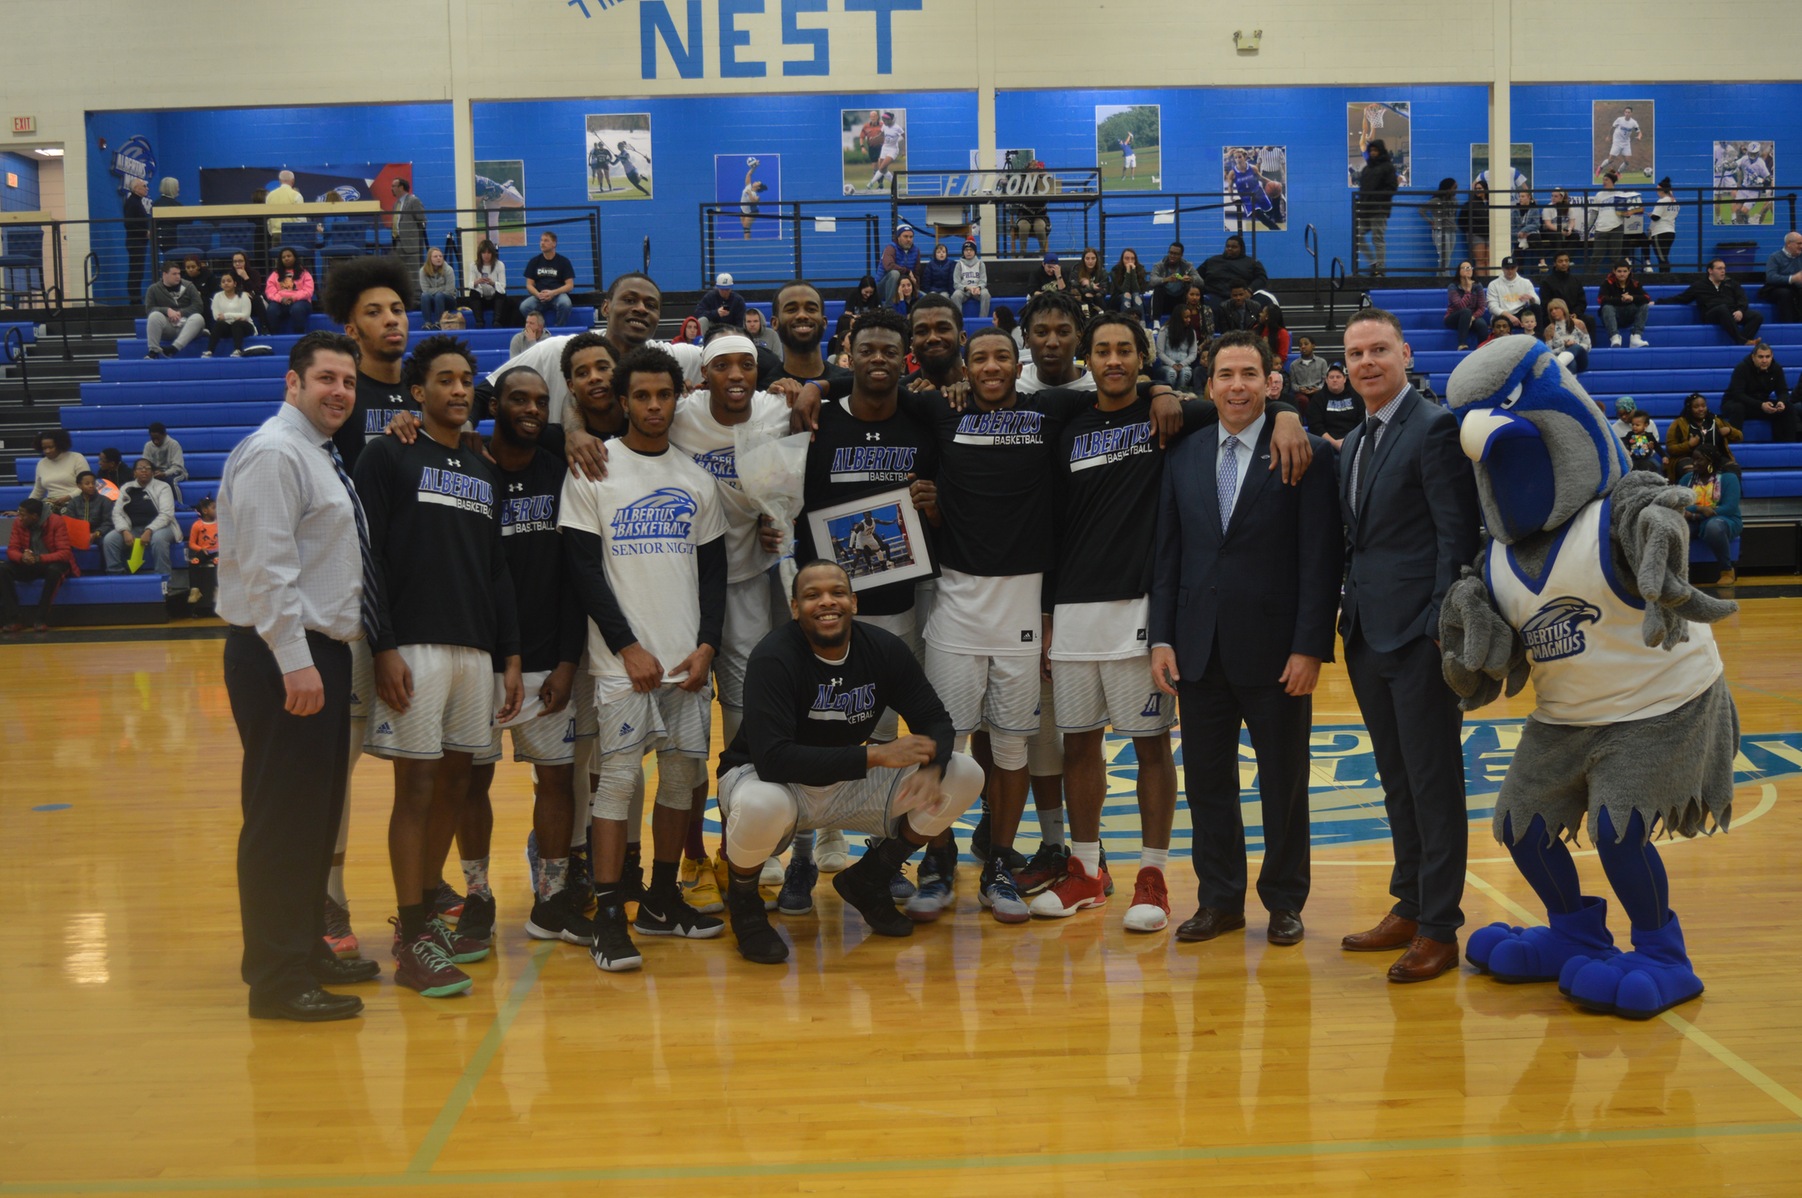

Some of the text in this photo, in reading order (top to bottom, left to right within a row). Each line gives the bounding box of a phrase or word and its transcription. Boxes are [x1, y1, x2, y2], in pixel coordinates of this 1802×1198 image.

[640, 0, 922, 79] NEST
[14, 117, 31, 130] EXIT
[943, 173, 1054, 197] FALCONS
[956, 411, 1045, 434] ALBERTUS
[994, 434, 1044, 445] BASKETBALL
[1070, 421, 1151, 462] ALBERTUS
[831, 446, 917, 472] ALBERTUS
[418, 466, 494, 506] ALBERTUS
[869, 472, 908, 482] BASKETBA
[614, 508, 676, 524] ALBERTUS
[616, 521, 688, 537] BASKETBALL
[612, 541, 696, 556] SENIOR NIGT
[1531, 633, 1580, 659] MAGNUS
